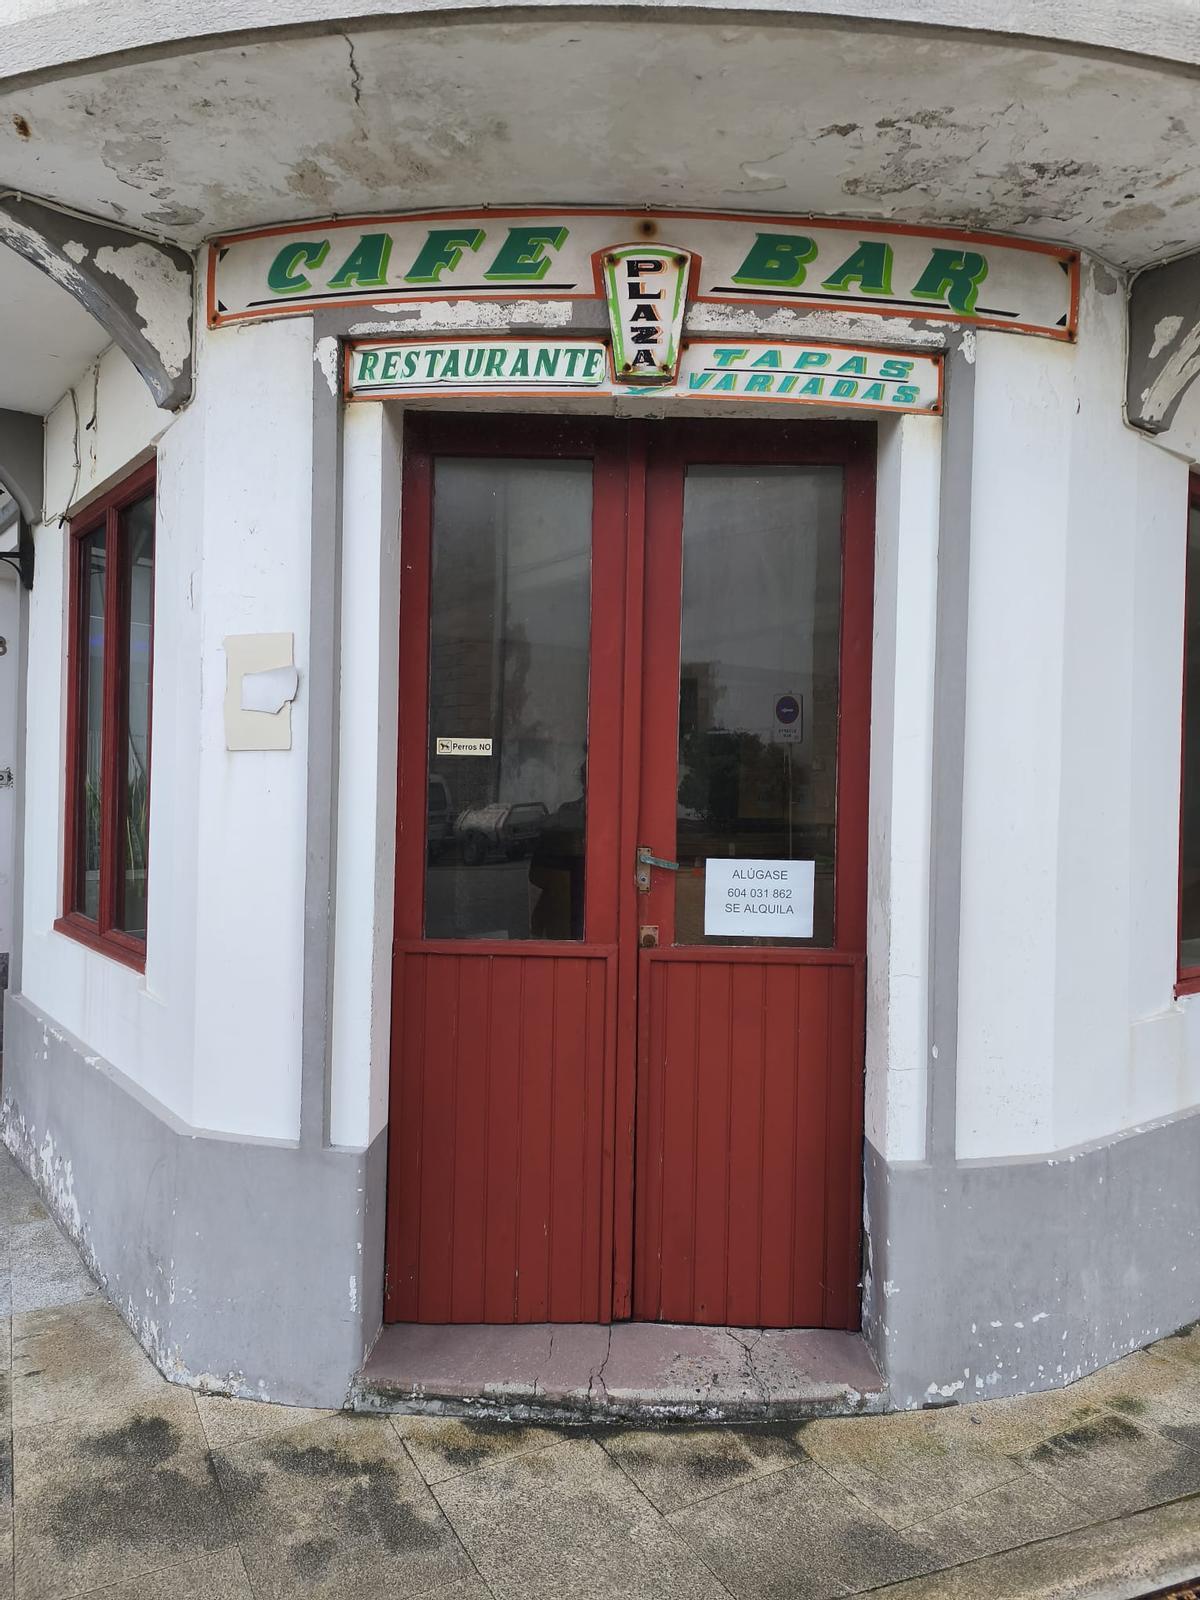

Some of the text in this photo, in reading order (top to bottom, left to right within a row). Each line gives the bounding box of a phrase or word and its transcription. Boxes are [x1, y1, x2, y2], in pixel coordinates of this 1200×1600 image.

[267, 226, 988, 315] CAFE BAR
[626, 259, 668, 367] PLAZA
[357, 348, 605, 381] RESTAURANTE
[712, 348, 915, 379] TAPAS
[688, 372, 921, 404] VARIADAS
[452, 742, 491, 751] Perros NO
[732, 867, 788, 880] ALÚGASE
[725, 903, 794, 915] SE ALQUILA
[727, 888, 792, 899] 604 031 862
